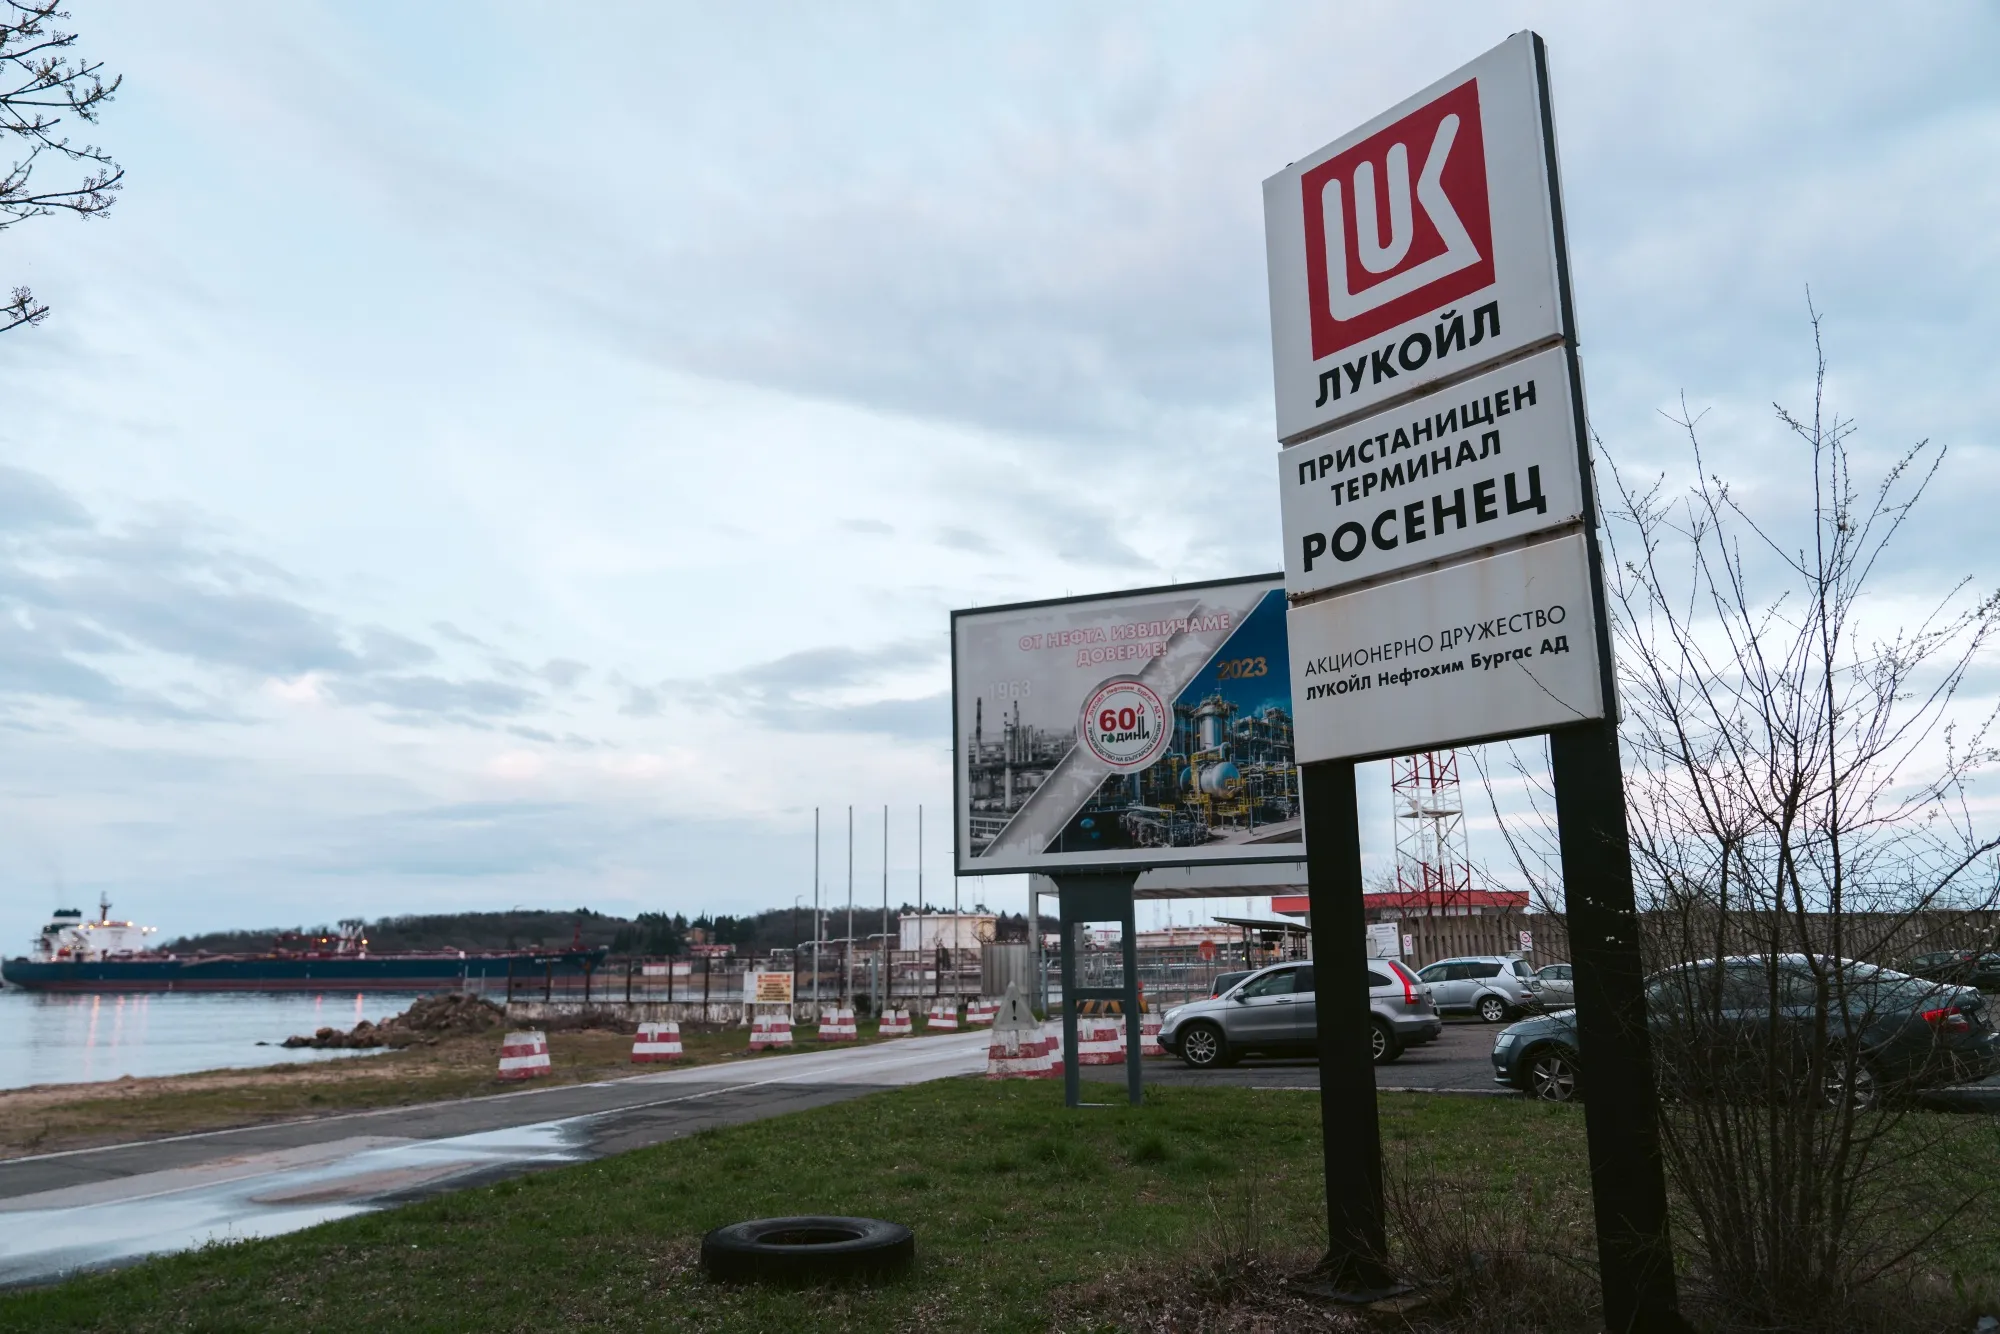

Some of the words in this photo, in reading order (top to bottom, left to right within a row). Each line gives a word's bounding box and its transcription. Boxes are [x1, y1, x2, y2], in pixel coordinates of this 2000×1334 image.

[1315, 300, 1501, 408] ЛУКОЙЛ
[1299, 380, 1537, 485] ПРИСТАНИЩЕН
[1331, 430, 1501, 506] ТЕРМИНАЛ
[1302, 464, 1547, 573] РОСЕНЕЦ
[1019, 635, 1042, 651] ОТ
[1047, 628, 1107, 648] НЕФТА
[1111, 614, 1230, 640] ИЗВЛИЧАМЕ
[1077, 641, 1168, 667] ДОВЕРИЕ!
[1305, 634, 1434, 677] АКЦИОНЕРНО
[1440, 605, 1566, 651] ДРУЖЕСТВО
[988, 680, 1031, 700] 1963
[1216, 656, 1268, 680] 2023
[1306, 675, 1371, 701] ЛУКОЙЛ
[1378, 659, 1464, 687] Нефтохим
[1471, 646, 1532, 670] Бургас
[1540, 635, 1570, 655] АД
[1100, 707, 1136, 732] 60
